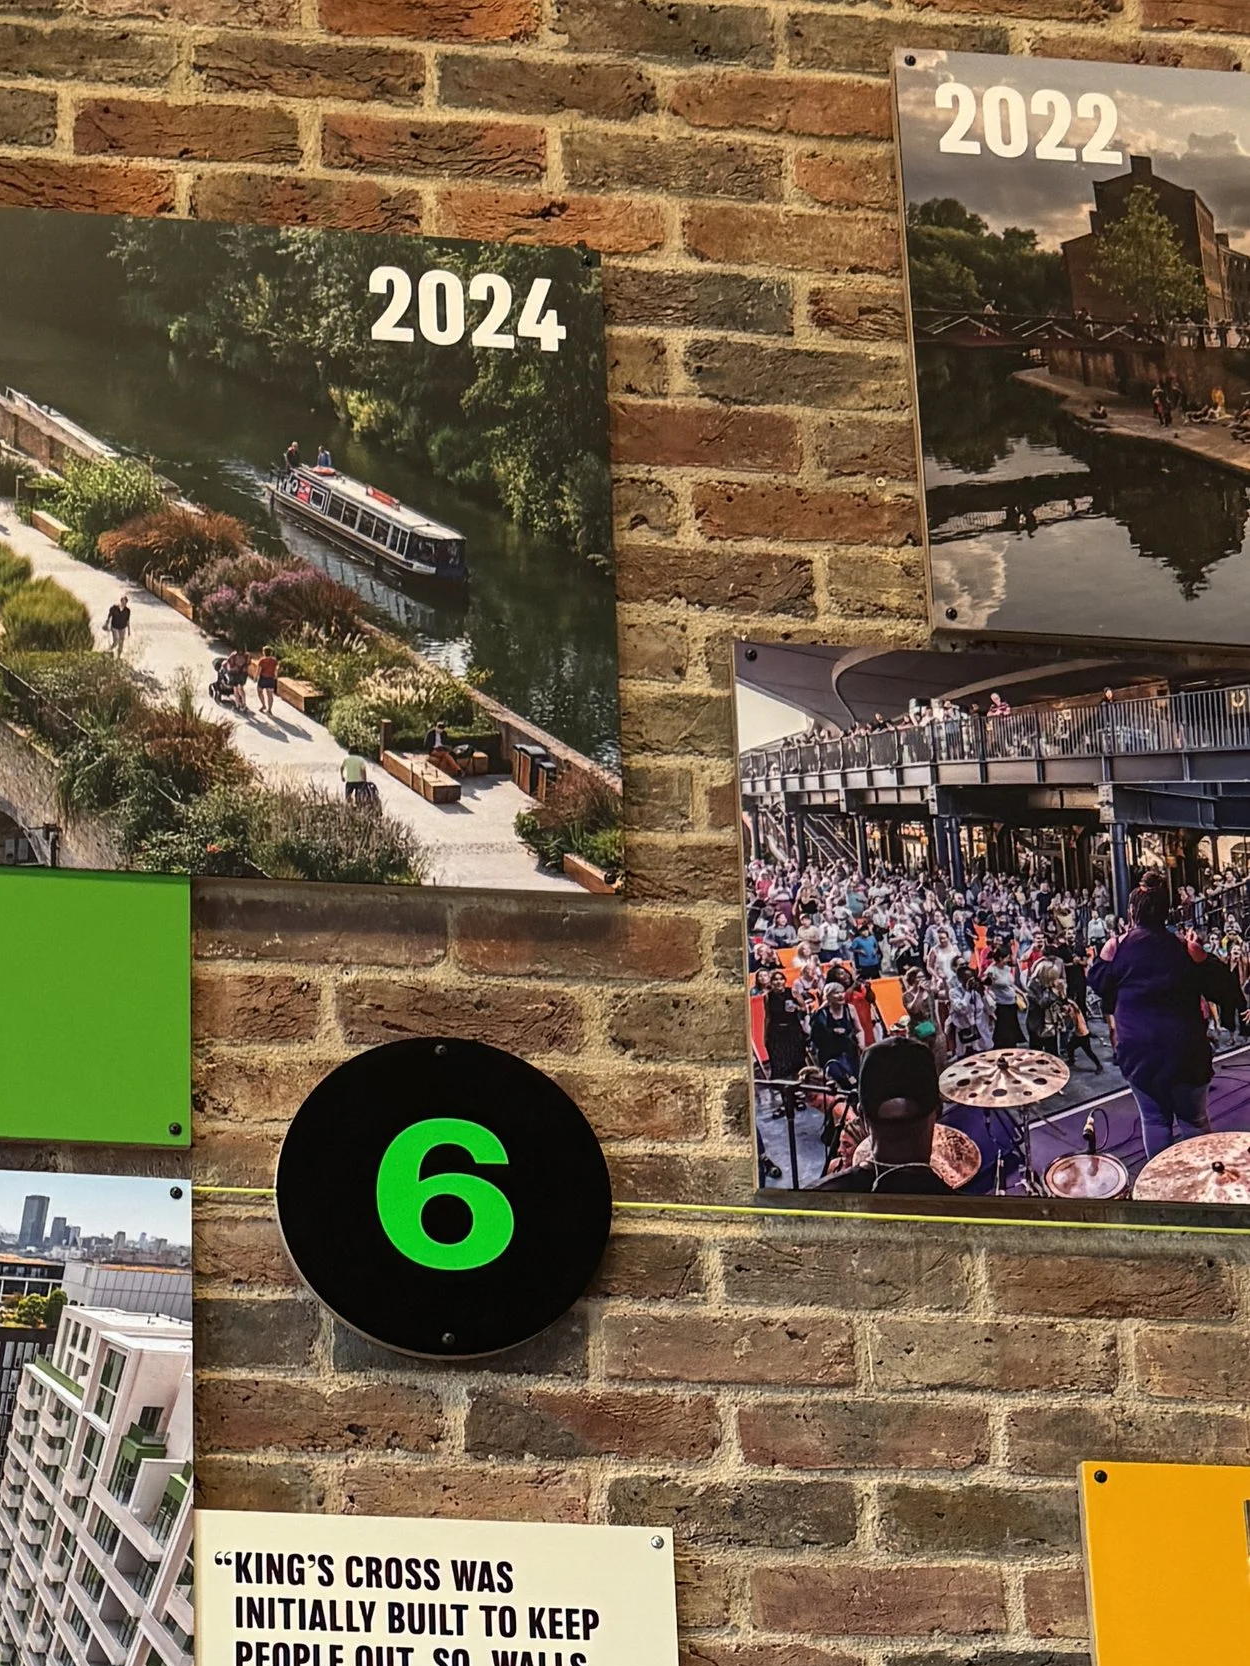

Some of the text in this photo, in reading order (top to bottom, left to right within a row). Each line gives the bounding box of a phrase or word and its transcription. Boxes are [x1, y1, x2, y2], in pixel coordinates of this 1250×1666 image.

[935, 82, 1123, 165] 2022
[369, 266, 566, 352] 2024
[376, 1117, 515, 1271] 6
[214, 1551, 514, 1594] “KING’S CROSS WAS
[235, 1596, 600, 1641] INITIALLY BUILT TO KEEP
